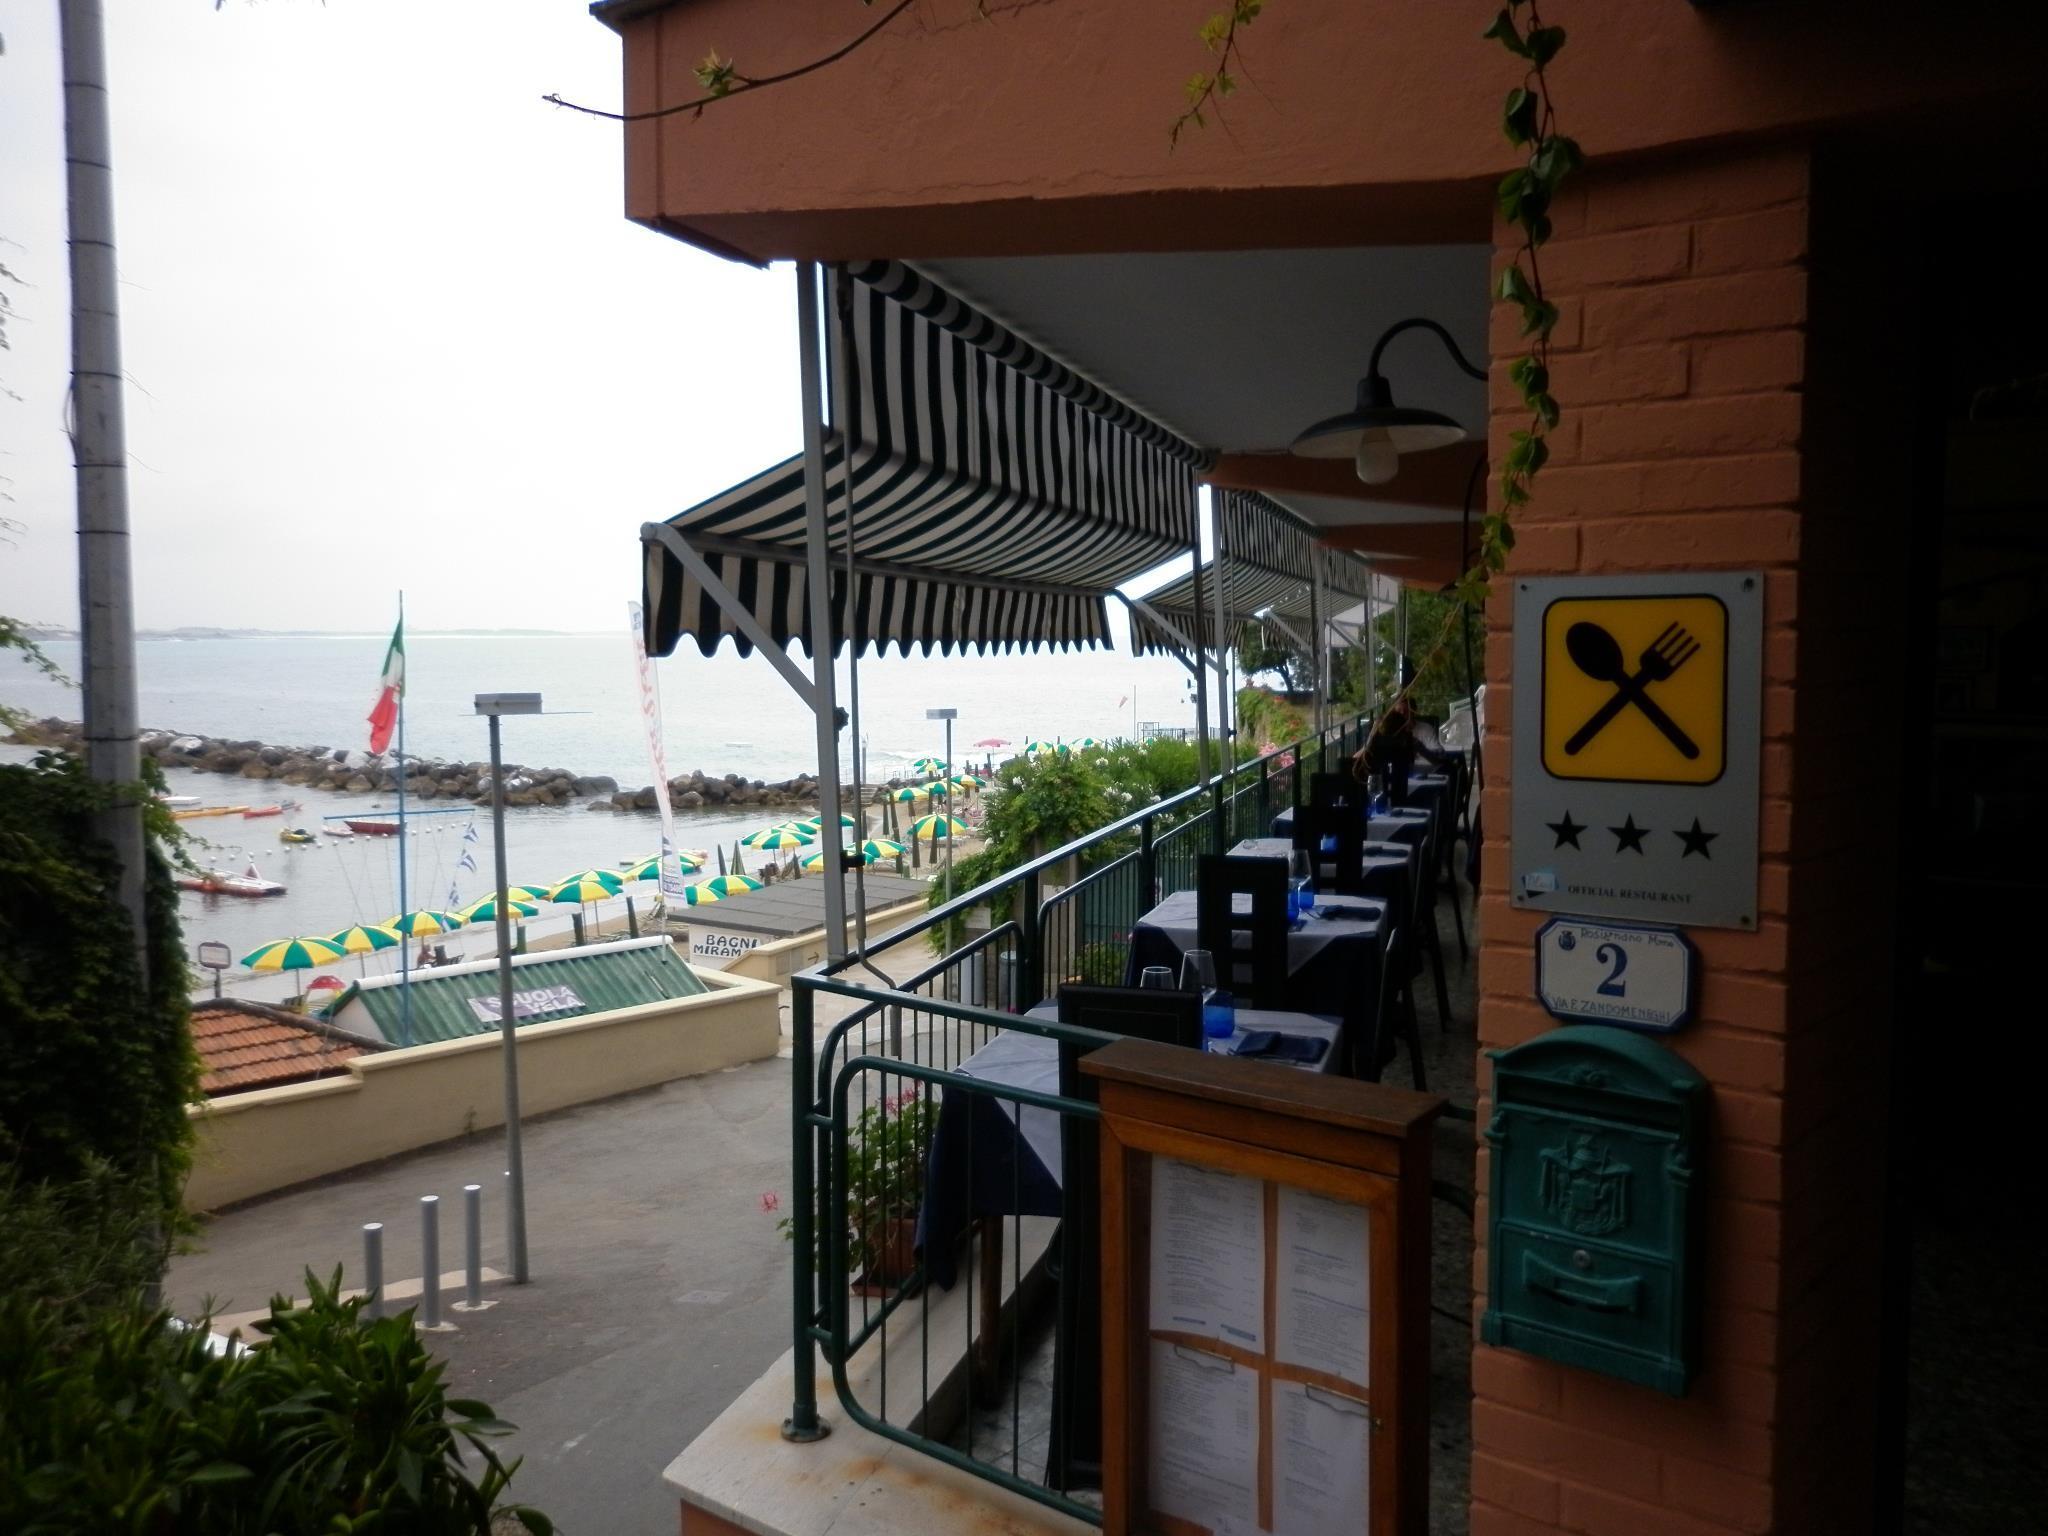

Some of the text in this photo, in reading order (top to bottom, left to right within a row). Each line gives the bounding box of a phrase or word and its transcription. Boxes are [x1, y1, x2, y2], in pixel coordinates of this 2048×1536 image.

[1568, 886, 1692, 903] OFFICIAL RESTAURANT
[706, 934, 757, 949] BAGNI
[1596, 943, 1628, 998] 2
[488, 986, 575, 1008] SUOLA
[526, 996, 585, 1013] VELA
[1551, 996, 1569, 1010] VIA
